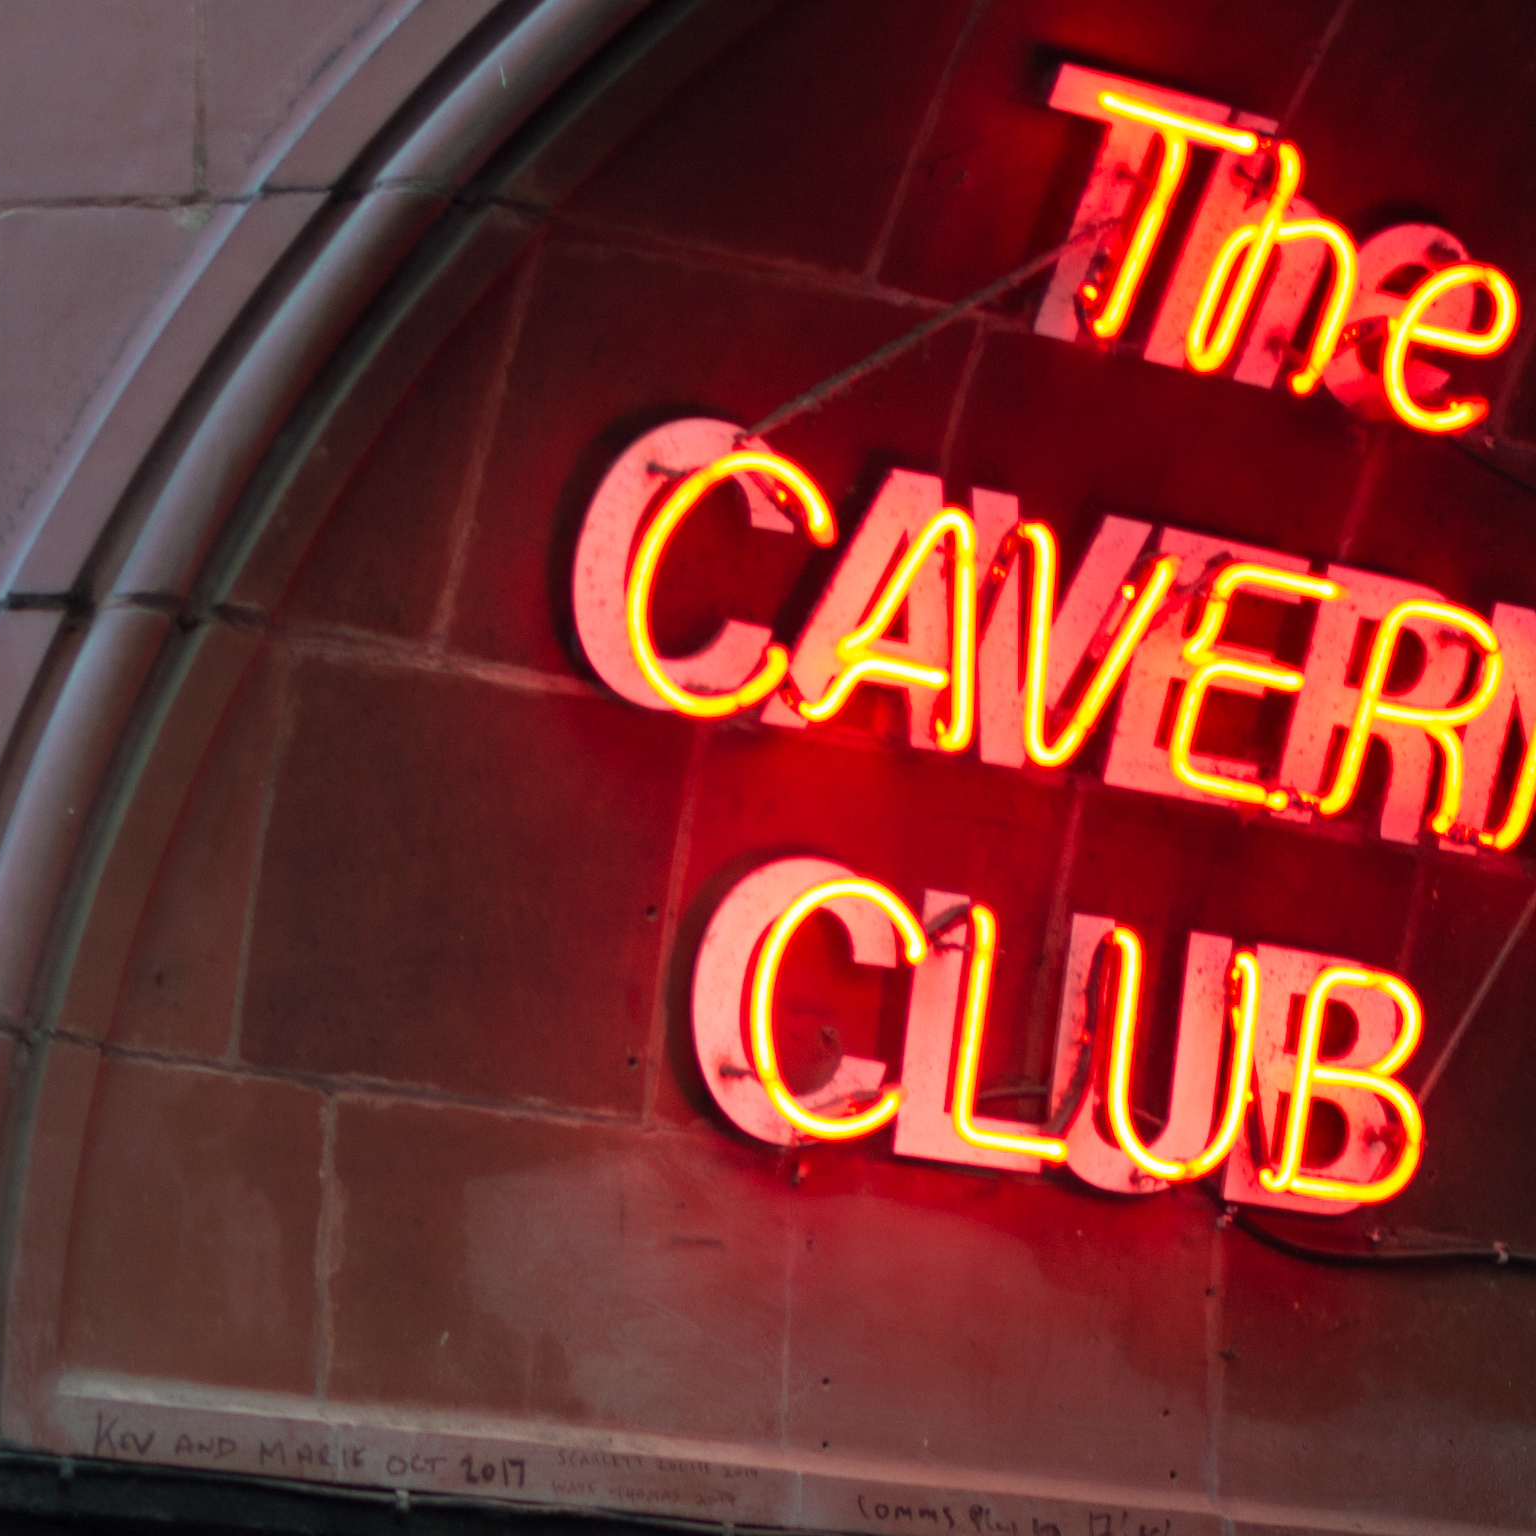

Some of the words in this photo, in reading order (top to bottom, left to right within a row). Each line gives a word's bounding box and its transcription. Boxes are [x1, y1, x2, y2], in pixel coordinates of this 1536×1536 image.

[1032, 62, 1520, 432] The
[690, 856, 1424, 1215] CLUB
[175, 1433, 236, 1455] AND
[461, 1457, 526, 1487] 2017
